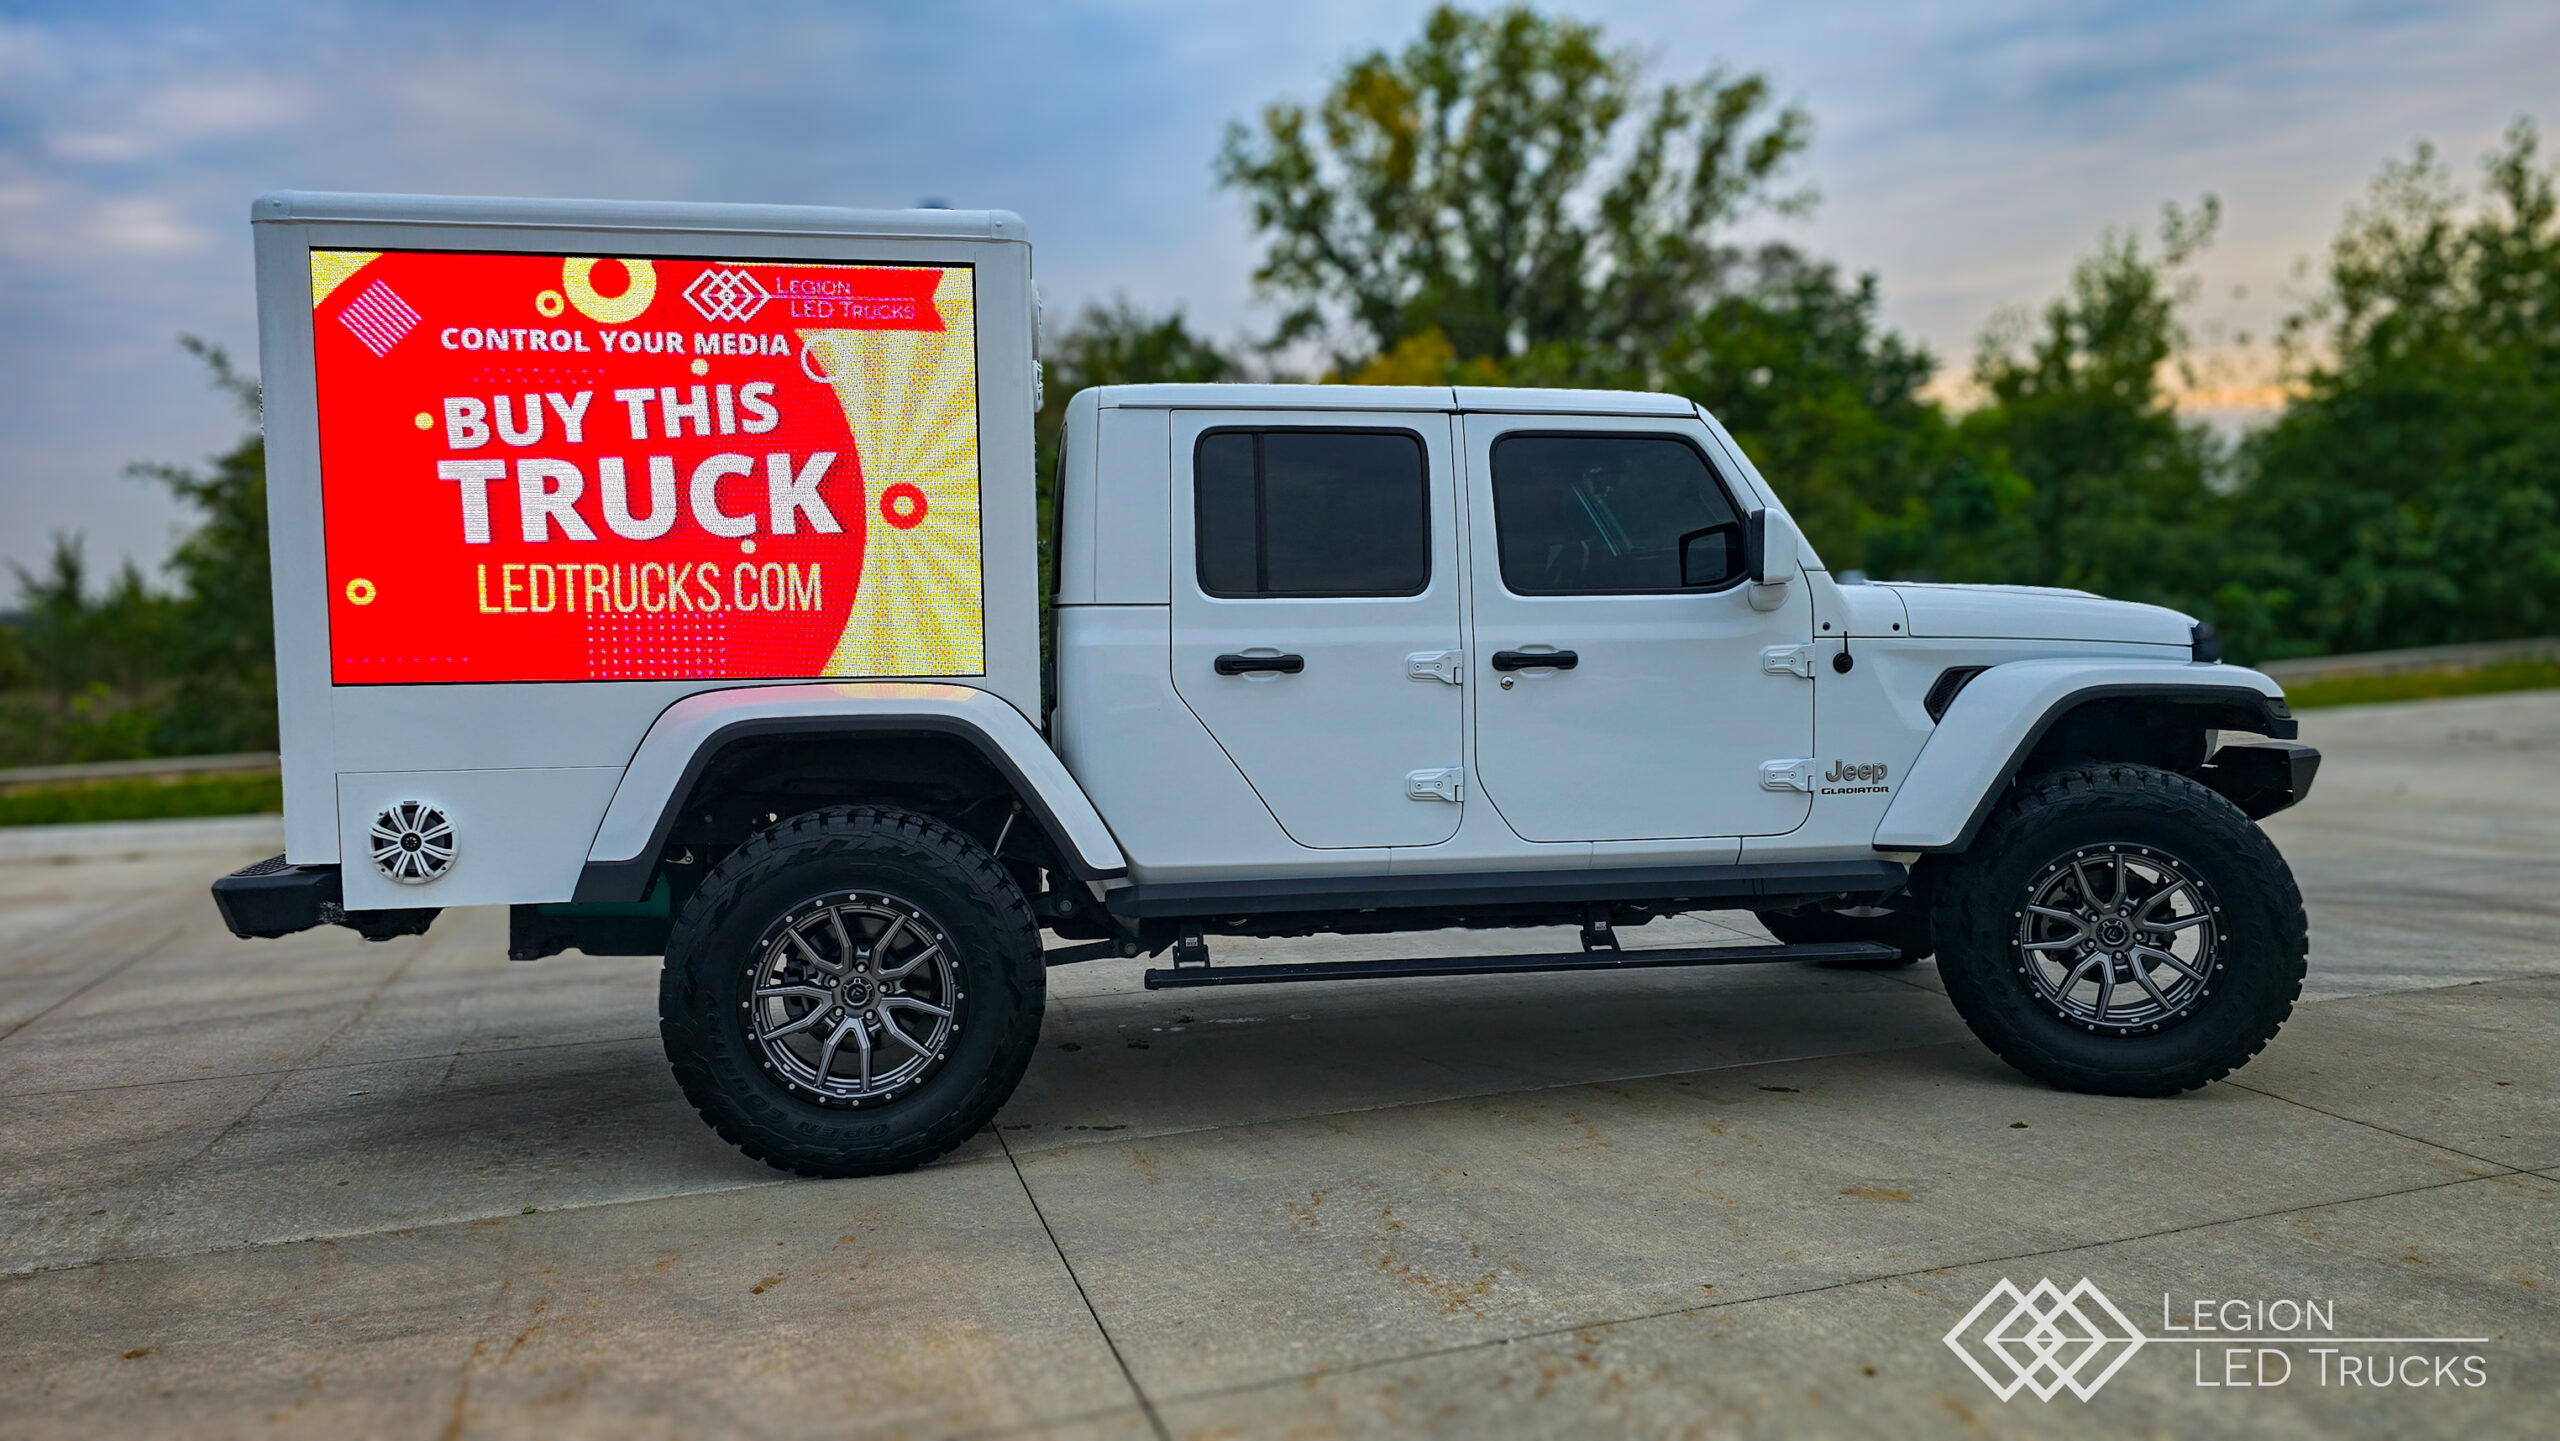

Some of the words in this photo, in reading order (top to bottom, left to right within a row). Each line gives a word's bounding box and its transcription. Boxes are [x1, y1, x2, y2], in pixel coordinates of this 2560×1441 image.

[776, 277, 851, 294] LEGION
[791, 301, 834, 318] LED
[839, 301, 915, 320] TRUCKS
[440, 327, 591, 352] CONTROL
[599, 330, 686, 354] YOUR
[694, 332, 791, 357] MEDIA
[443, 391, 593, 450] BUY
[614, 381, 780, 440] THIS
[437, 452, 845, 544] TRUCK
[477, 562, 822, 614] LEDTRUCKS.COM
[1825, 760, 1888, 784] Jeep
[1821, 786, 1889, 795] GLADIATOR
